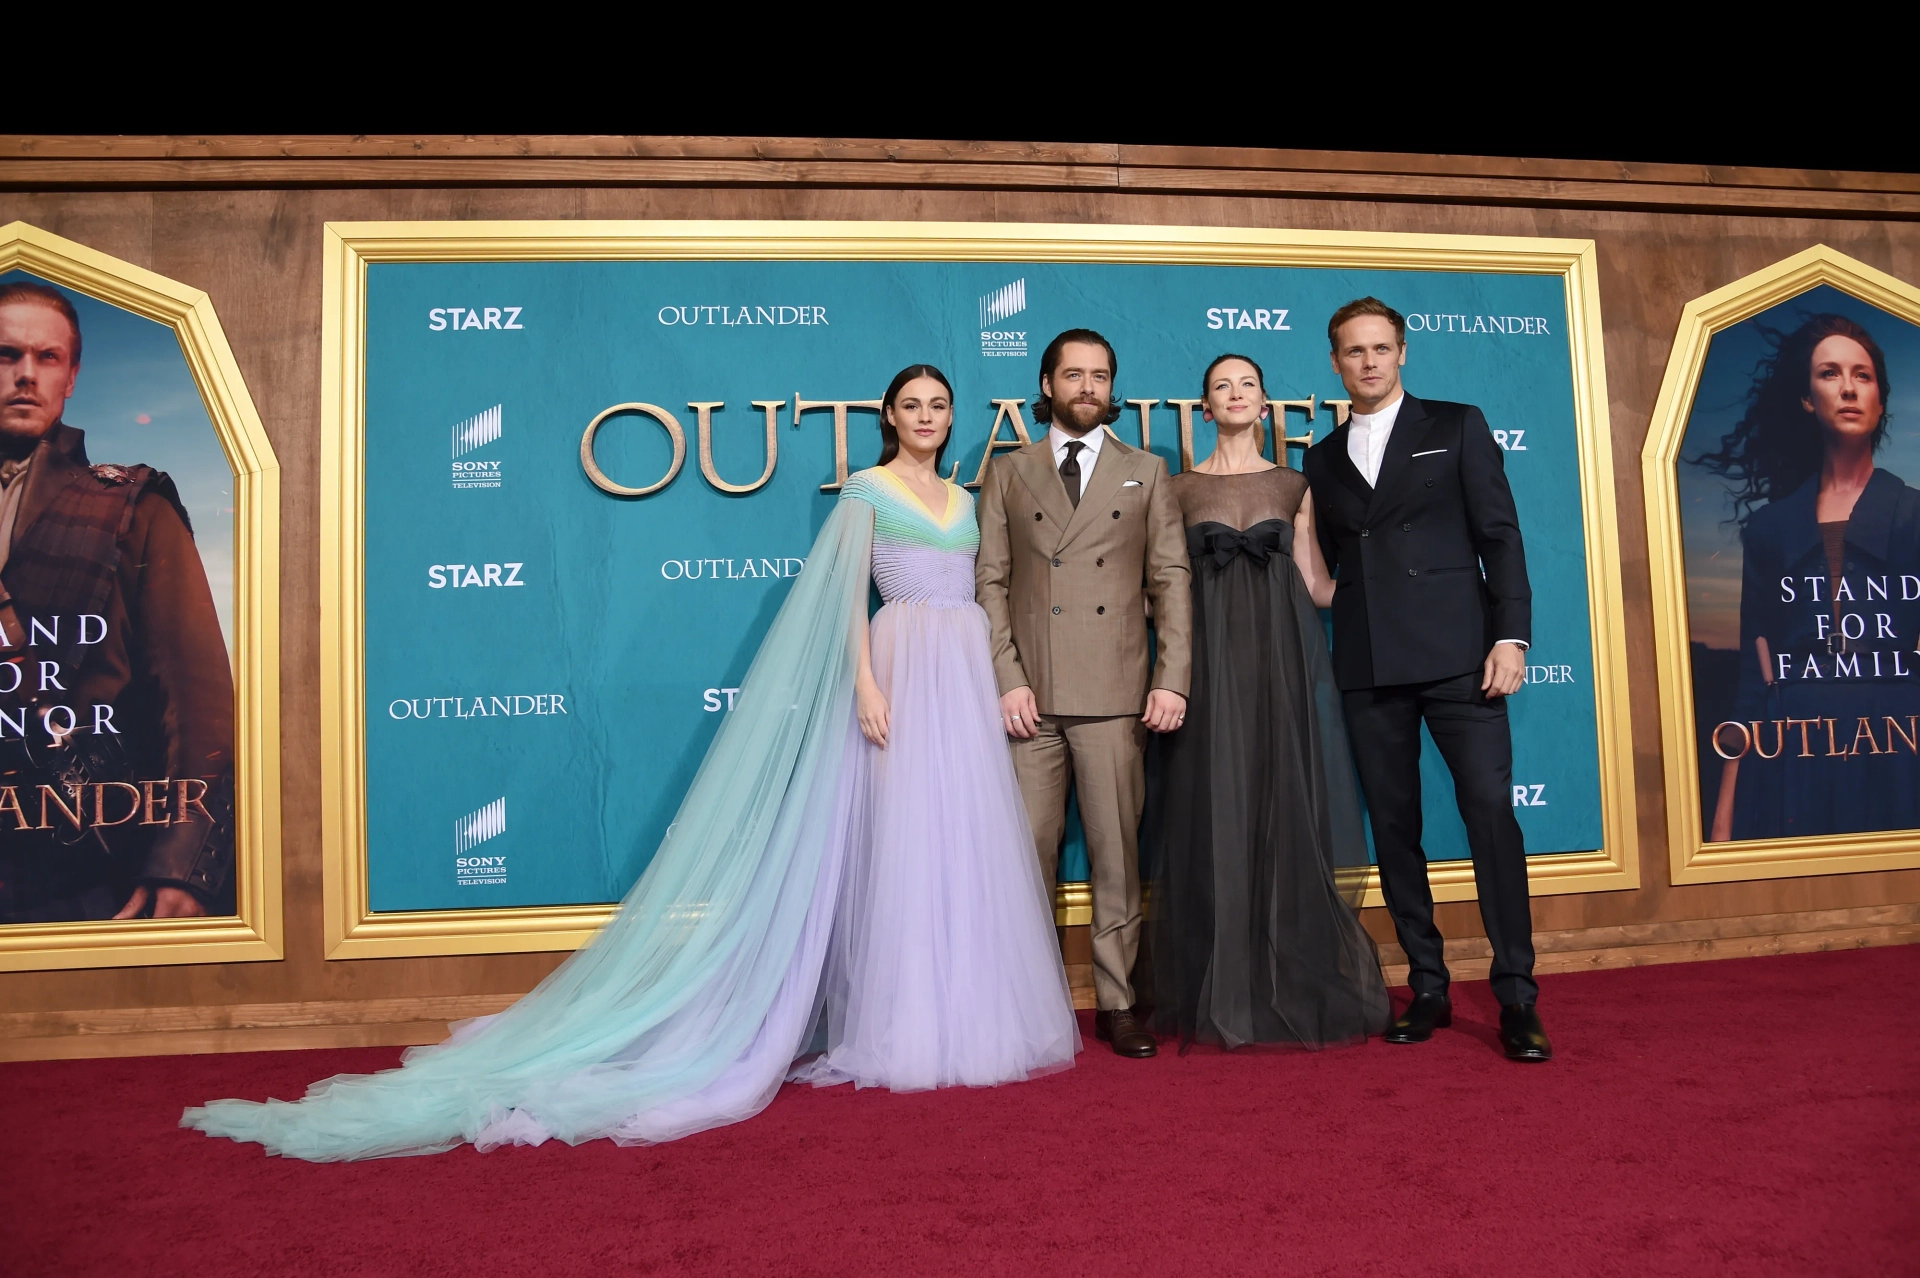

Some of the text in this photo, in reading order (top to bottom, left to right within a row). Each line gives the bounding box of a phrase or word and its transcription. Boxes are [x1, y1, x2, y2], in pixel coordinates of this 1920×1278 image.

[428, 306, 523, 331] STARZ
[658, 304, 829, 327] OUTLANDER
[1206, 307, 1291, 331] STARZ
[1406, 313, 1550, 336] OUTLANDER
[981, 331, 1027, 341] SONY
[453, 461, 501, 471] SONY
[428, 562, 524, 589] STARZ
[661, 557, 807, 581] OUTLAND
[1780, 575, 1920, 603] STAND
[1815, 612, 1898, 640] FOR
[1777, 650, 1920, 680] FAMIL
[388, 693, 568, 721] OUTLANDER
[456, 856, 506, 866] SONY
